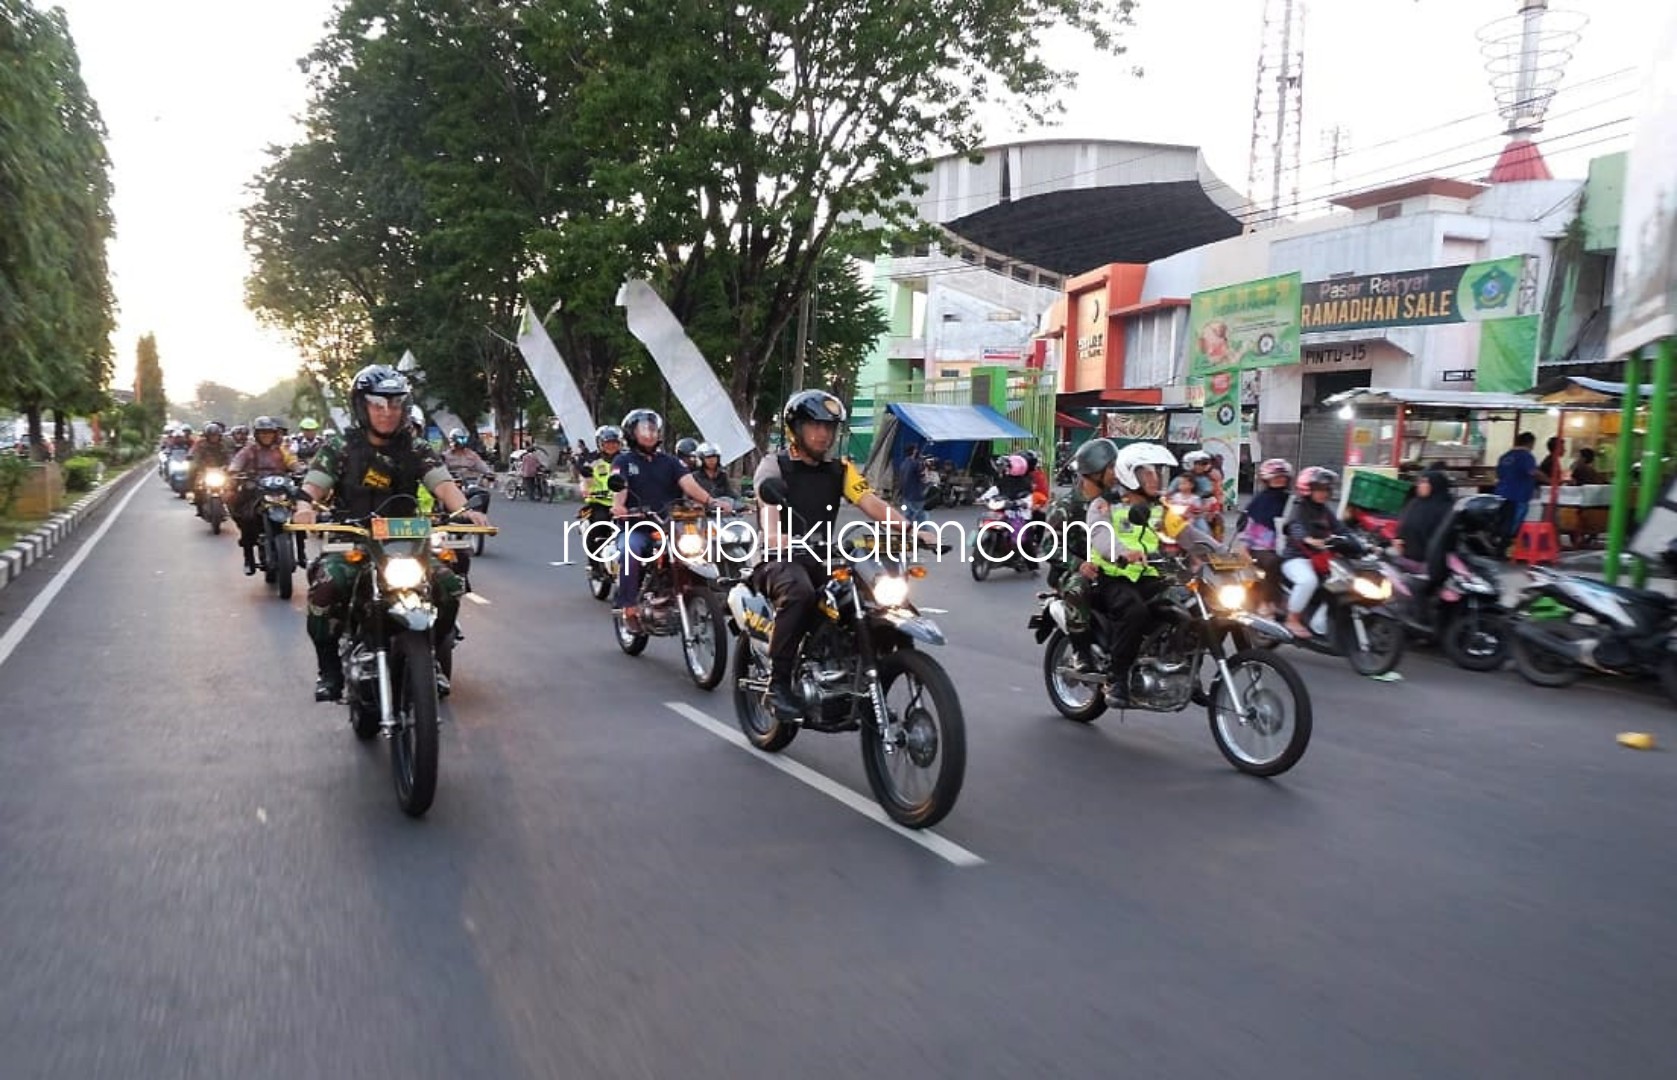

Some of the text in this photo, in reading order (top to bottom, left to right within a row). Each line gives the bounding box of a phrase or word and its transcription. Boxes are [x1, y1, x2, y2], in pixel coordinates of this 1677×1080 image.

[1319, 273, 1430, 299] Pasar Rakyat
[1301, 295, 1400, 328] RAMADHAN
[1402, 290, 1453, 319] SALE
